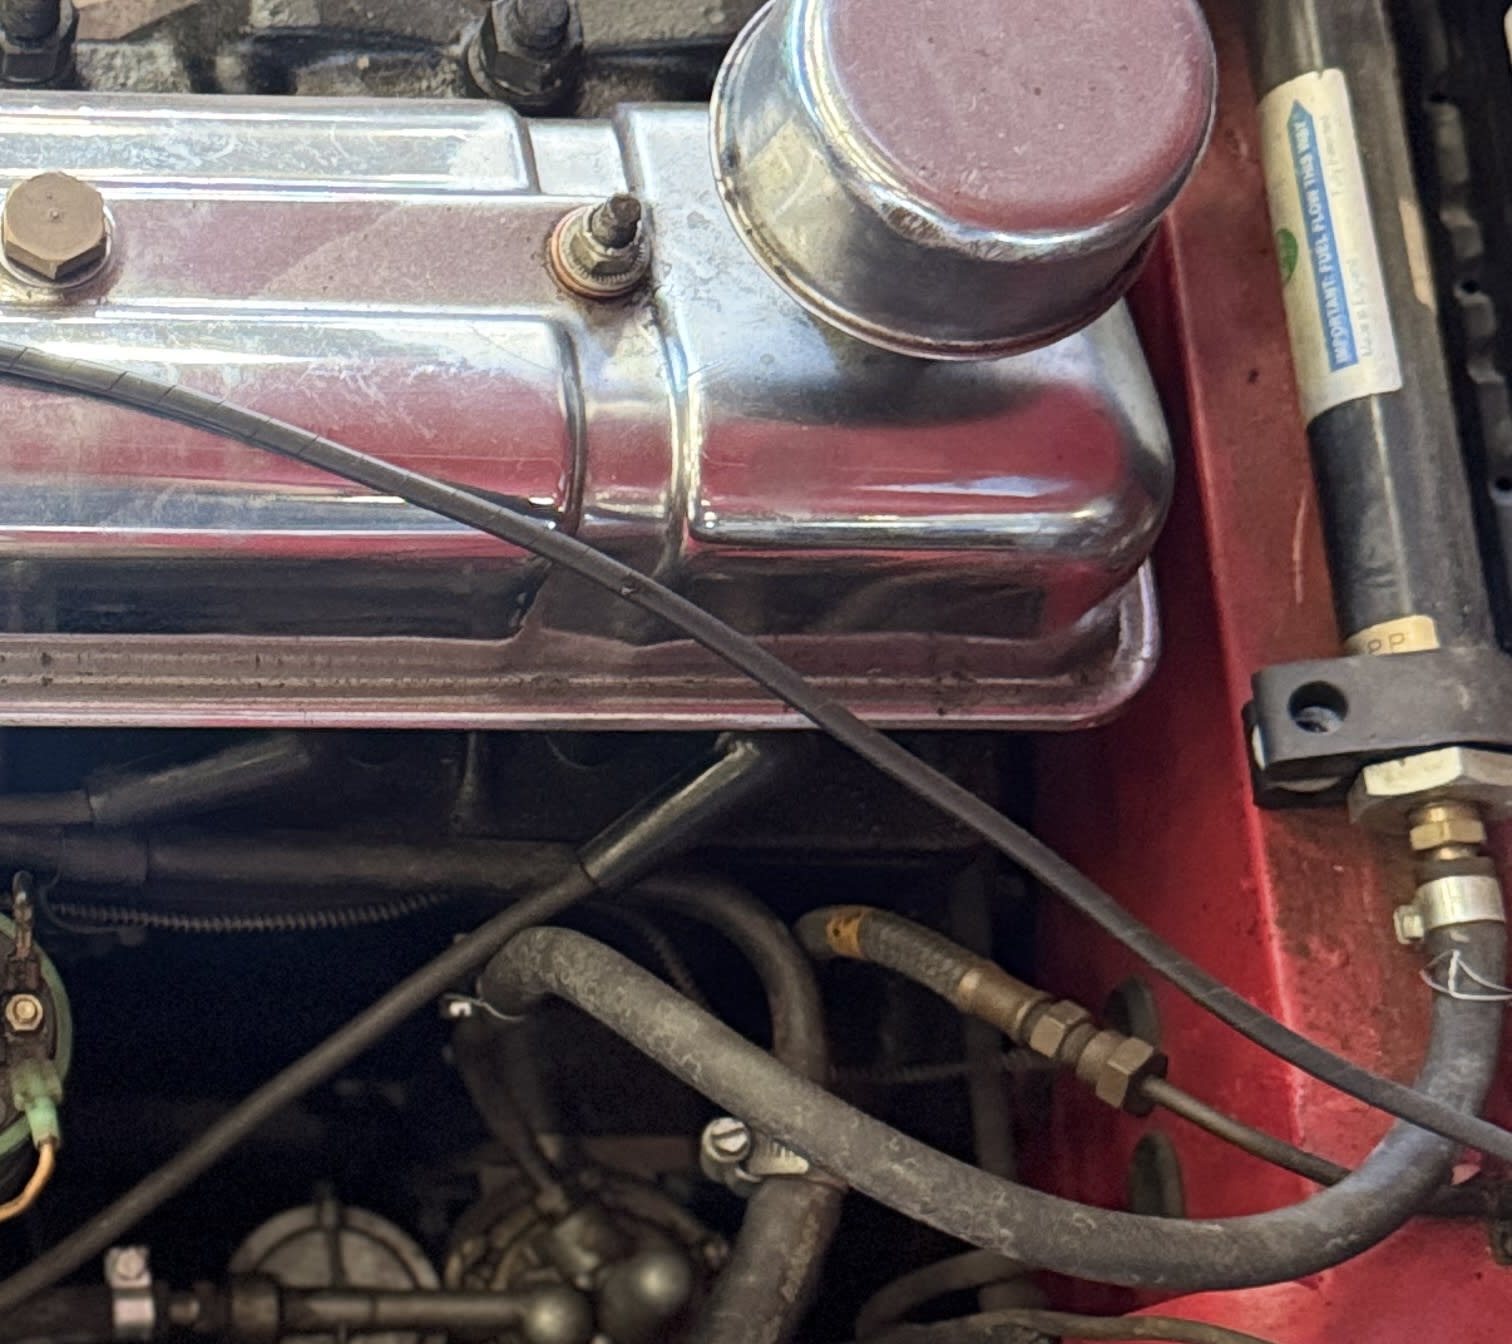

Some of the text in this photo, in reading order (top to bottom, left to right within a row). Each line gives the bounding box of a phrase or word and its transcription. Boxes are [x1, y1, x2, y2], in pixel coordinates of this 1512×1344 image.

[1299, 153, 1320, 191] THIS
[1306, 189, 1327, 236] FLOW
[1314, 234, 1336, 279] FUEL
